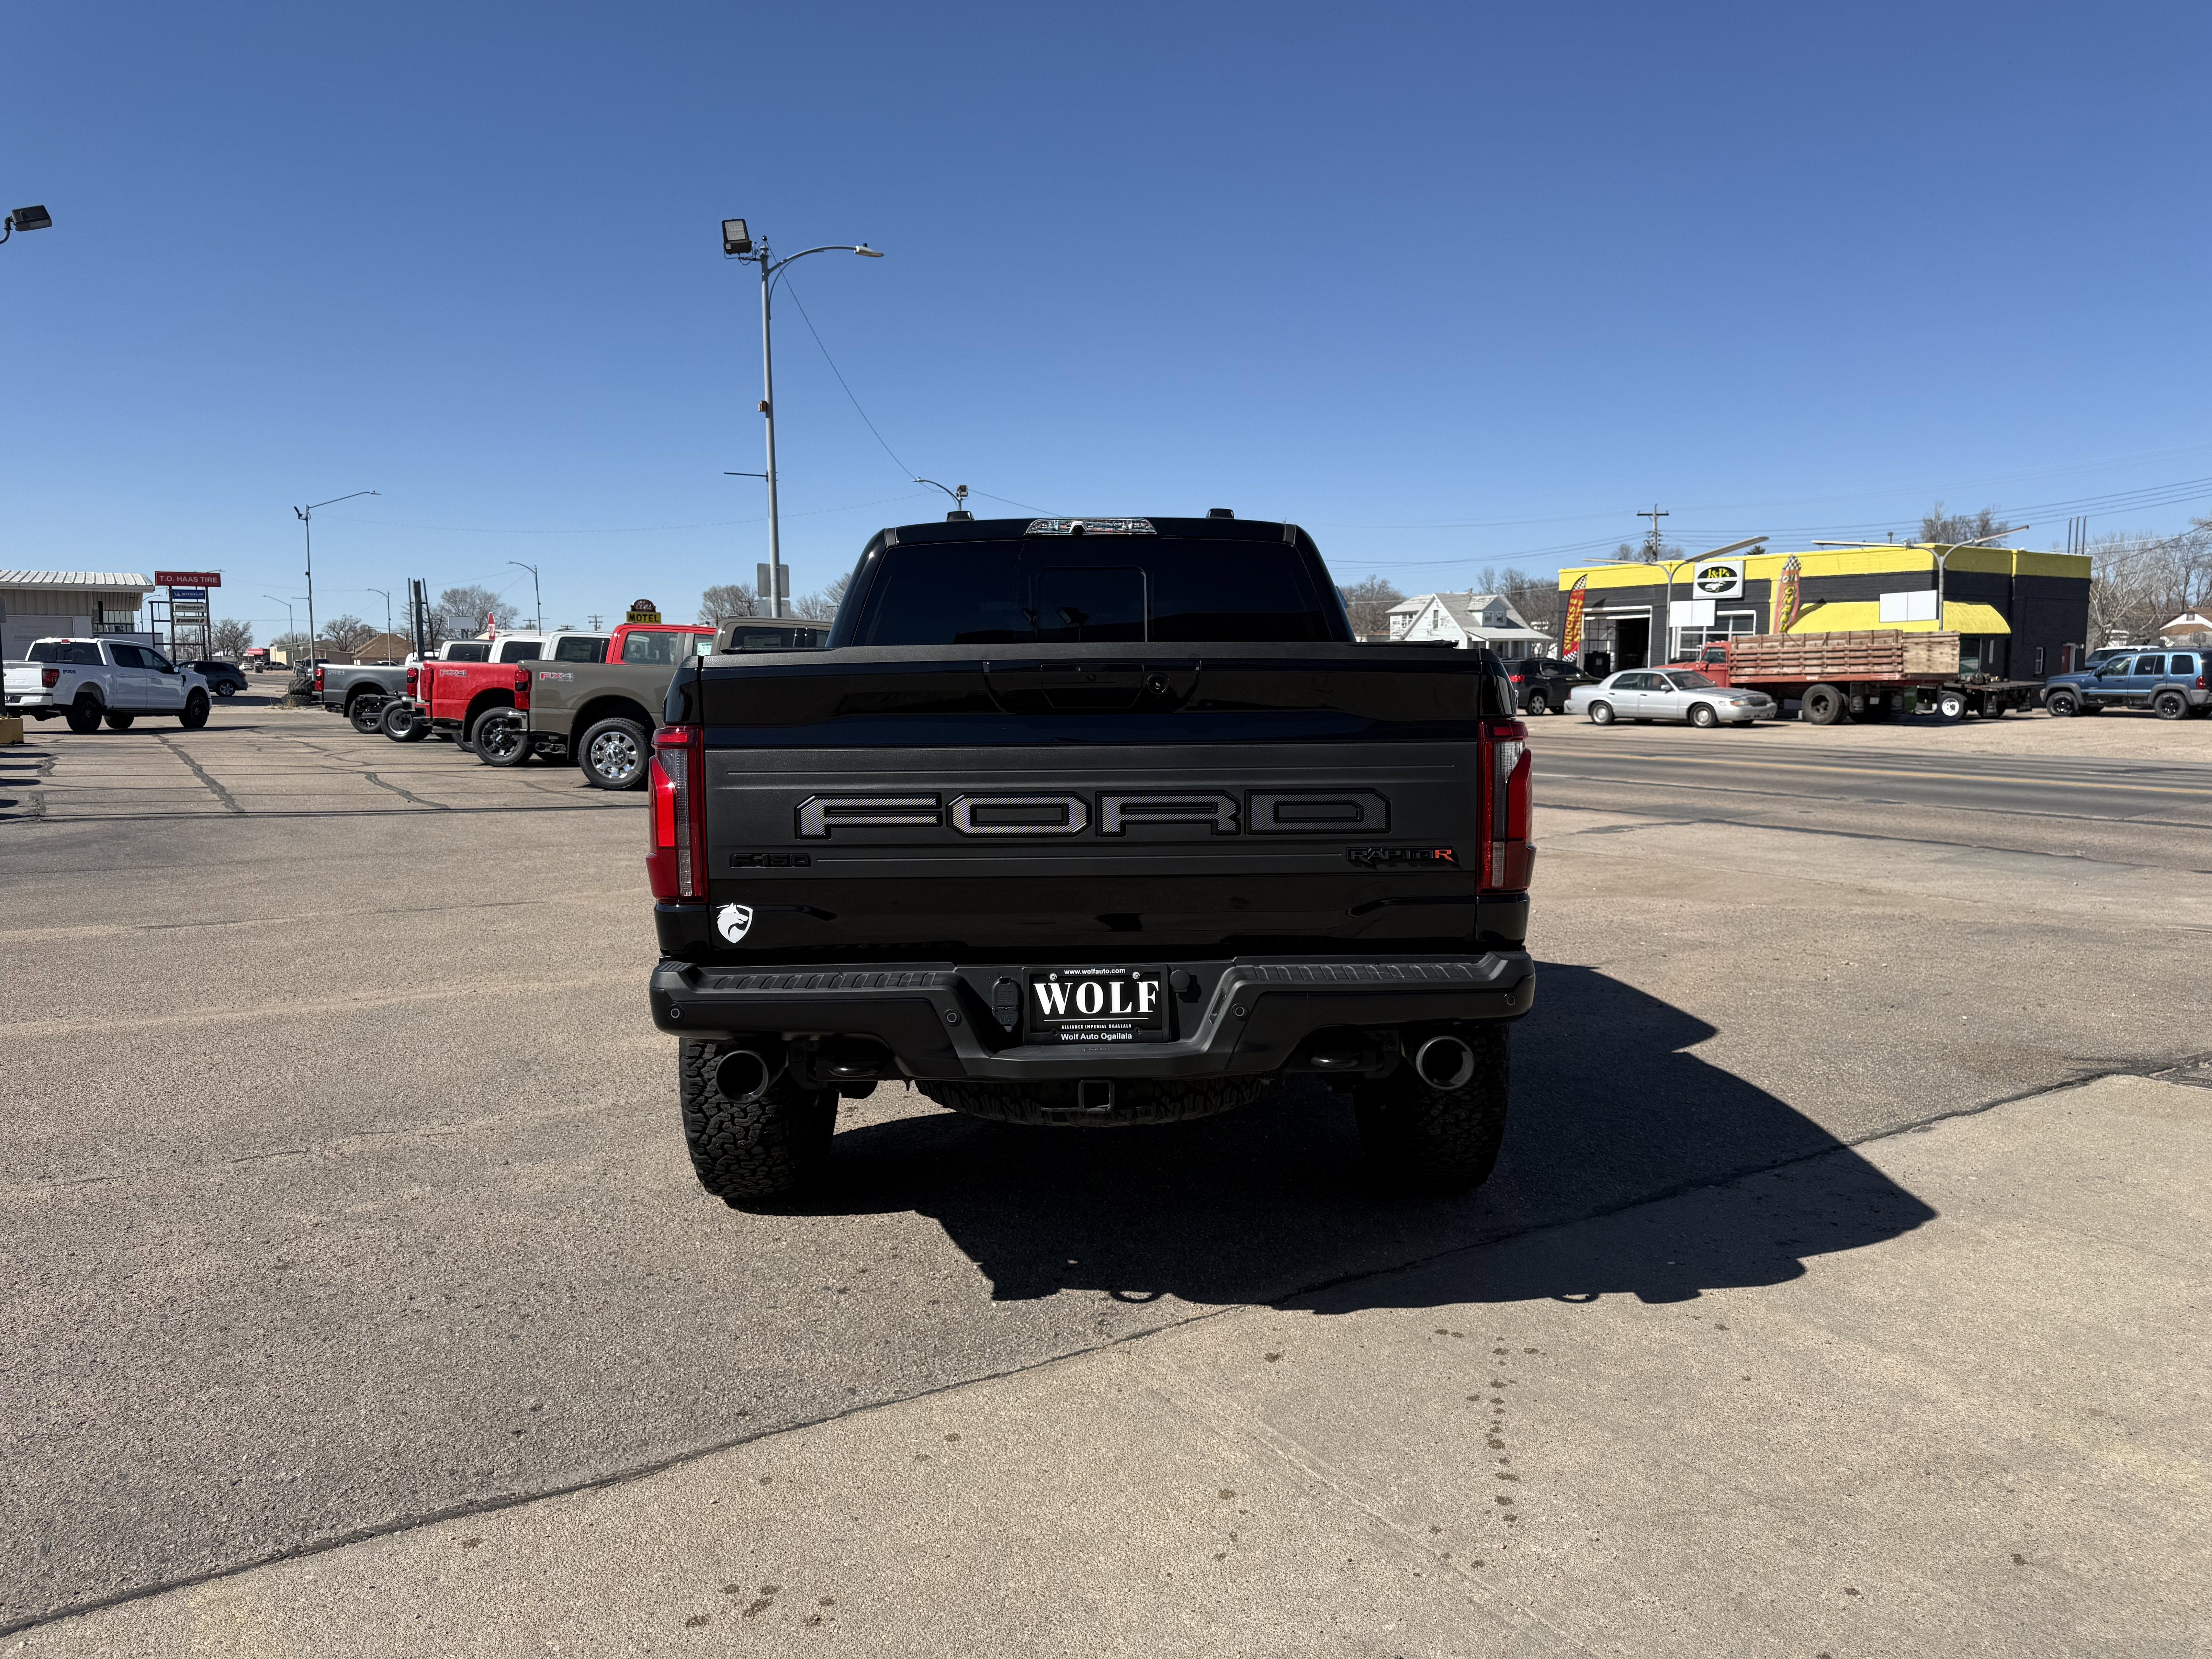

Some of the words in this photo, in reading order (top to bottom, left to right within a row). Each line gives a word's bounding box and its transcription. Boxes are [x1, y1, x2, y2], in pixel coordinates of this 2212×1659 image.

[1782, 574, 1797, 583] OIL
[629, 613, 659, 622] MOTEL
[1564, 606, 1576, 650] SHOCKS
[539, 672, 573, 680] FX4
[794, 788, 1391, 840] FORD
[730, 853, 811, 868] F-150
[1347, 847, 1458, 867] RAPTOR
[1033, 981, 1159, 1015] WOLF
[1101, 1032, 1132, 1041] Ogallala
